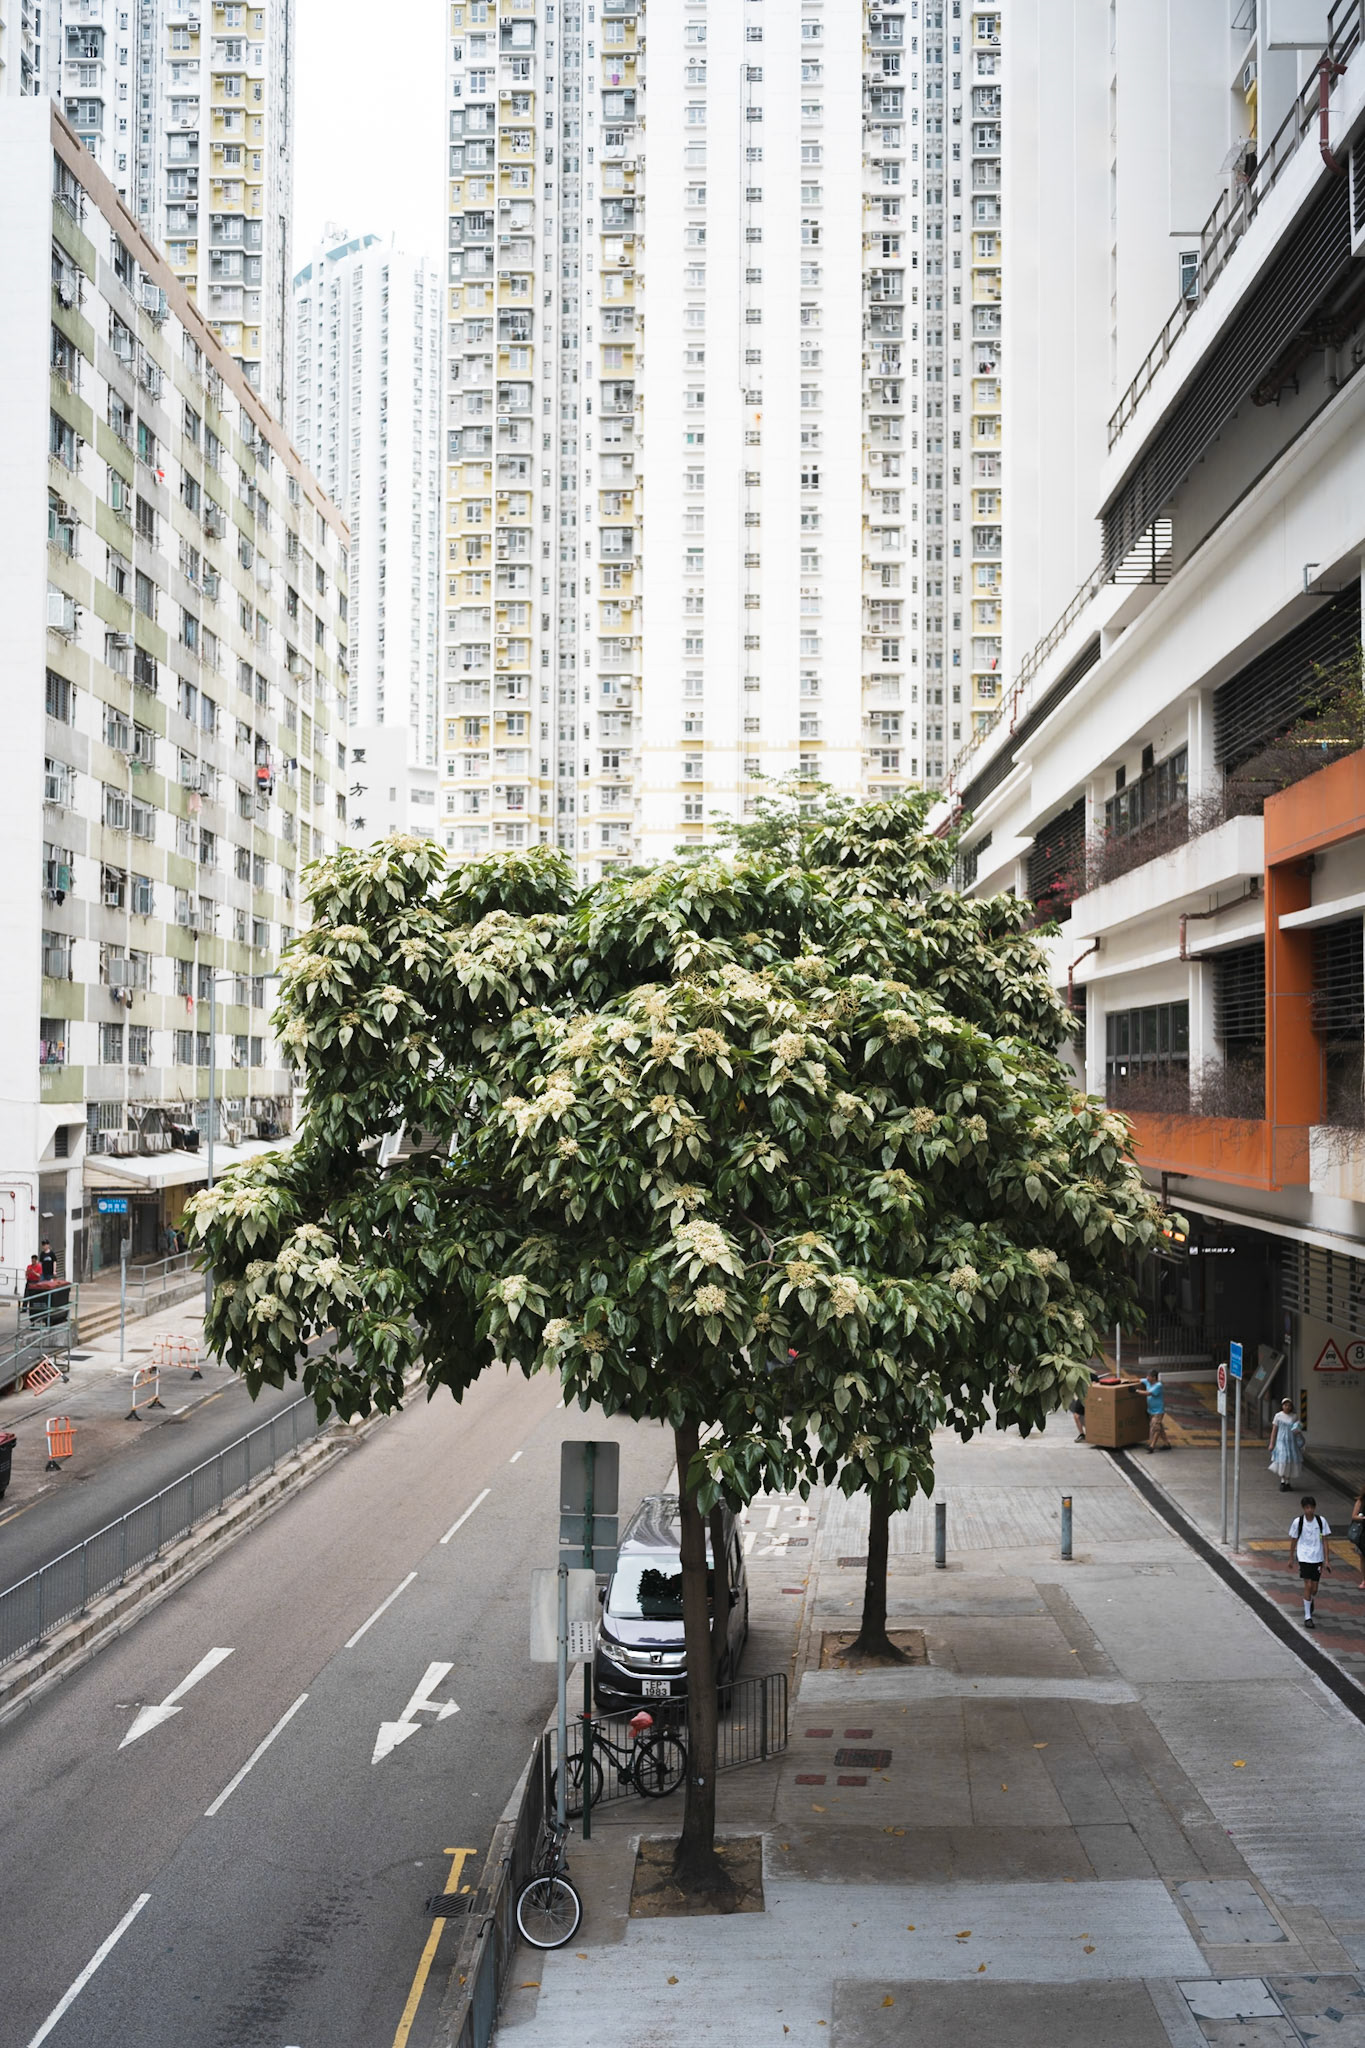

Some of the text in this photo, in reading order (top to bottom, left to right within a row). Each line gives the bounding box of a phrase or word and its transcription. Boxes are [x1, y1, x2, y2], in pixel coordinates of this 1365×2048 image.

[1355, 1345, 1365, 1360] 8
[650, 1680, 662, 1689] EP
[645, 1688, 668, 1696] 1983
